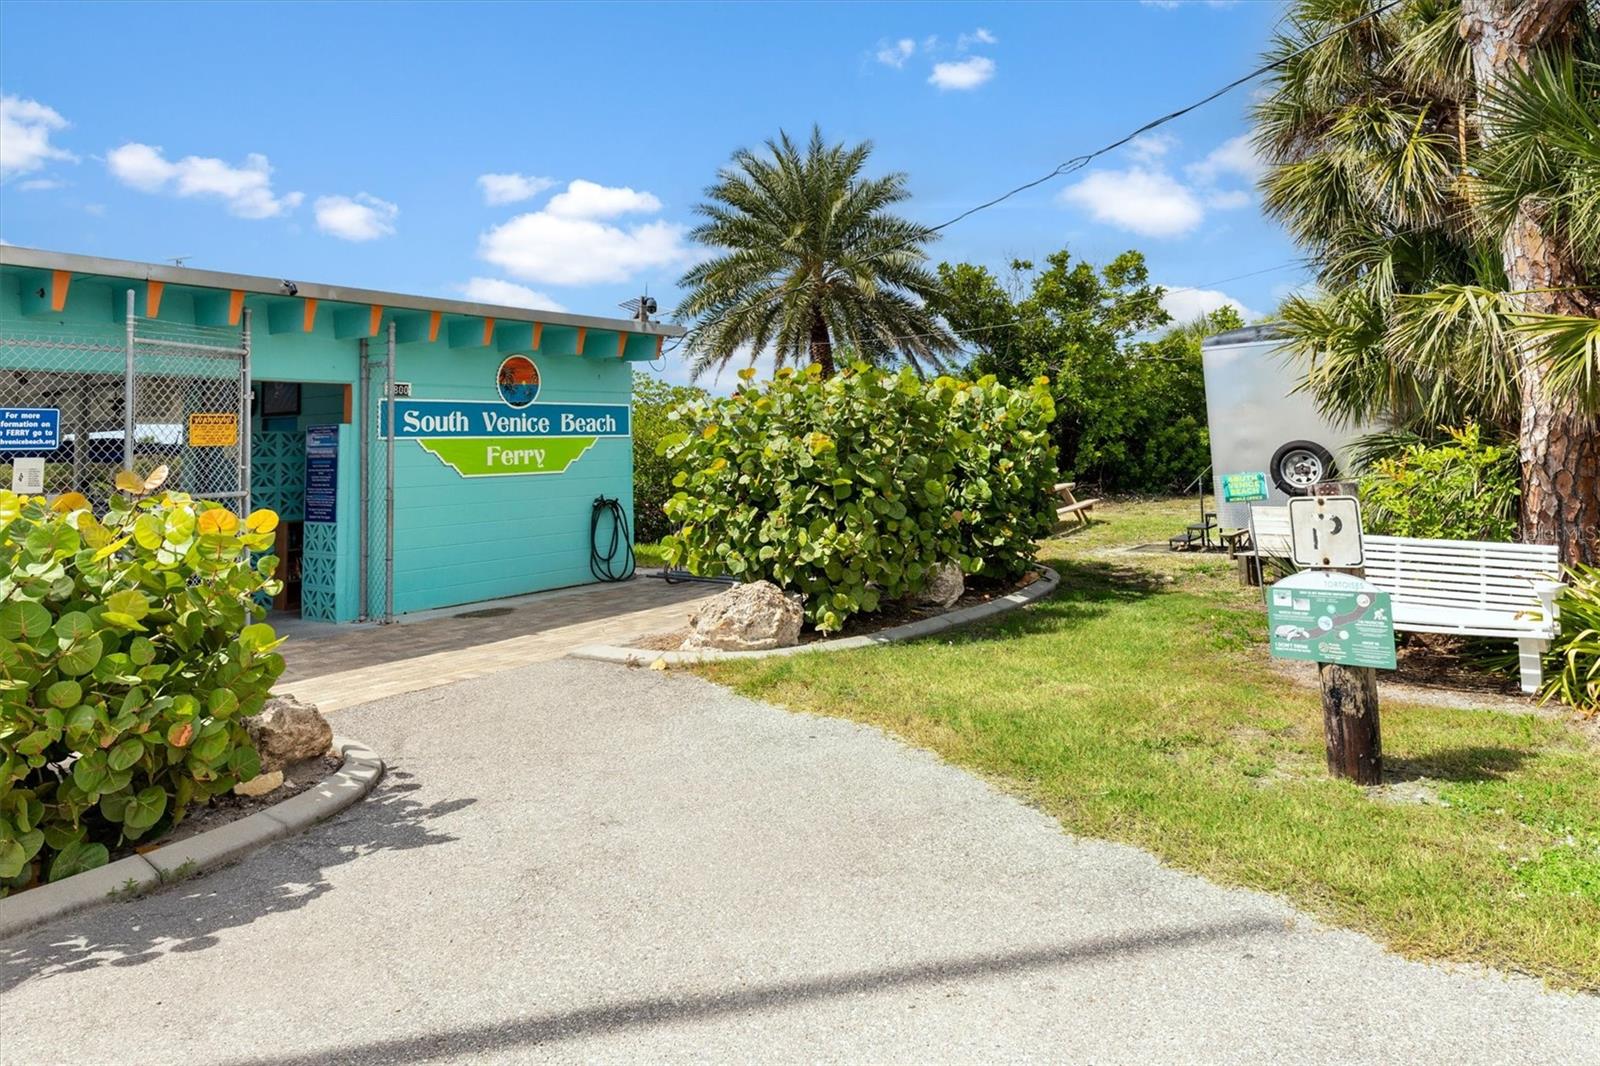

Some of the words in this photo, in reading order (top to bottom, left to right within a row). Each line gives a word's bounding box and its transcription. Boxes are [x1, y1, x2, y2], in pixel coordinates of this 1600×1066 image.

[5, 411, 19, 419] For
[403, 410, 469, 433] South
[482, 411, 550, 433] Venice
[560, 413, 616, 432] Beach
[32, 430, 42, 438] go
[486, 446, 545, 468] Ferry
[1324, 581, 1364, 590] TORTOISES
